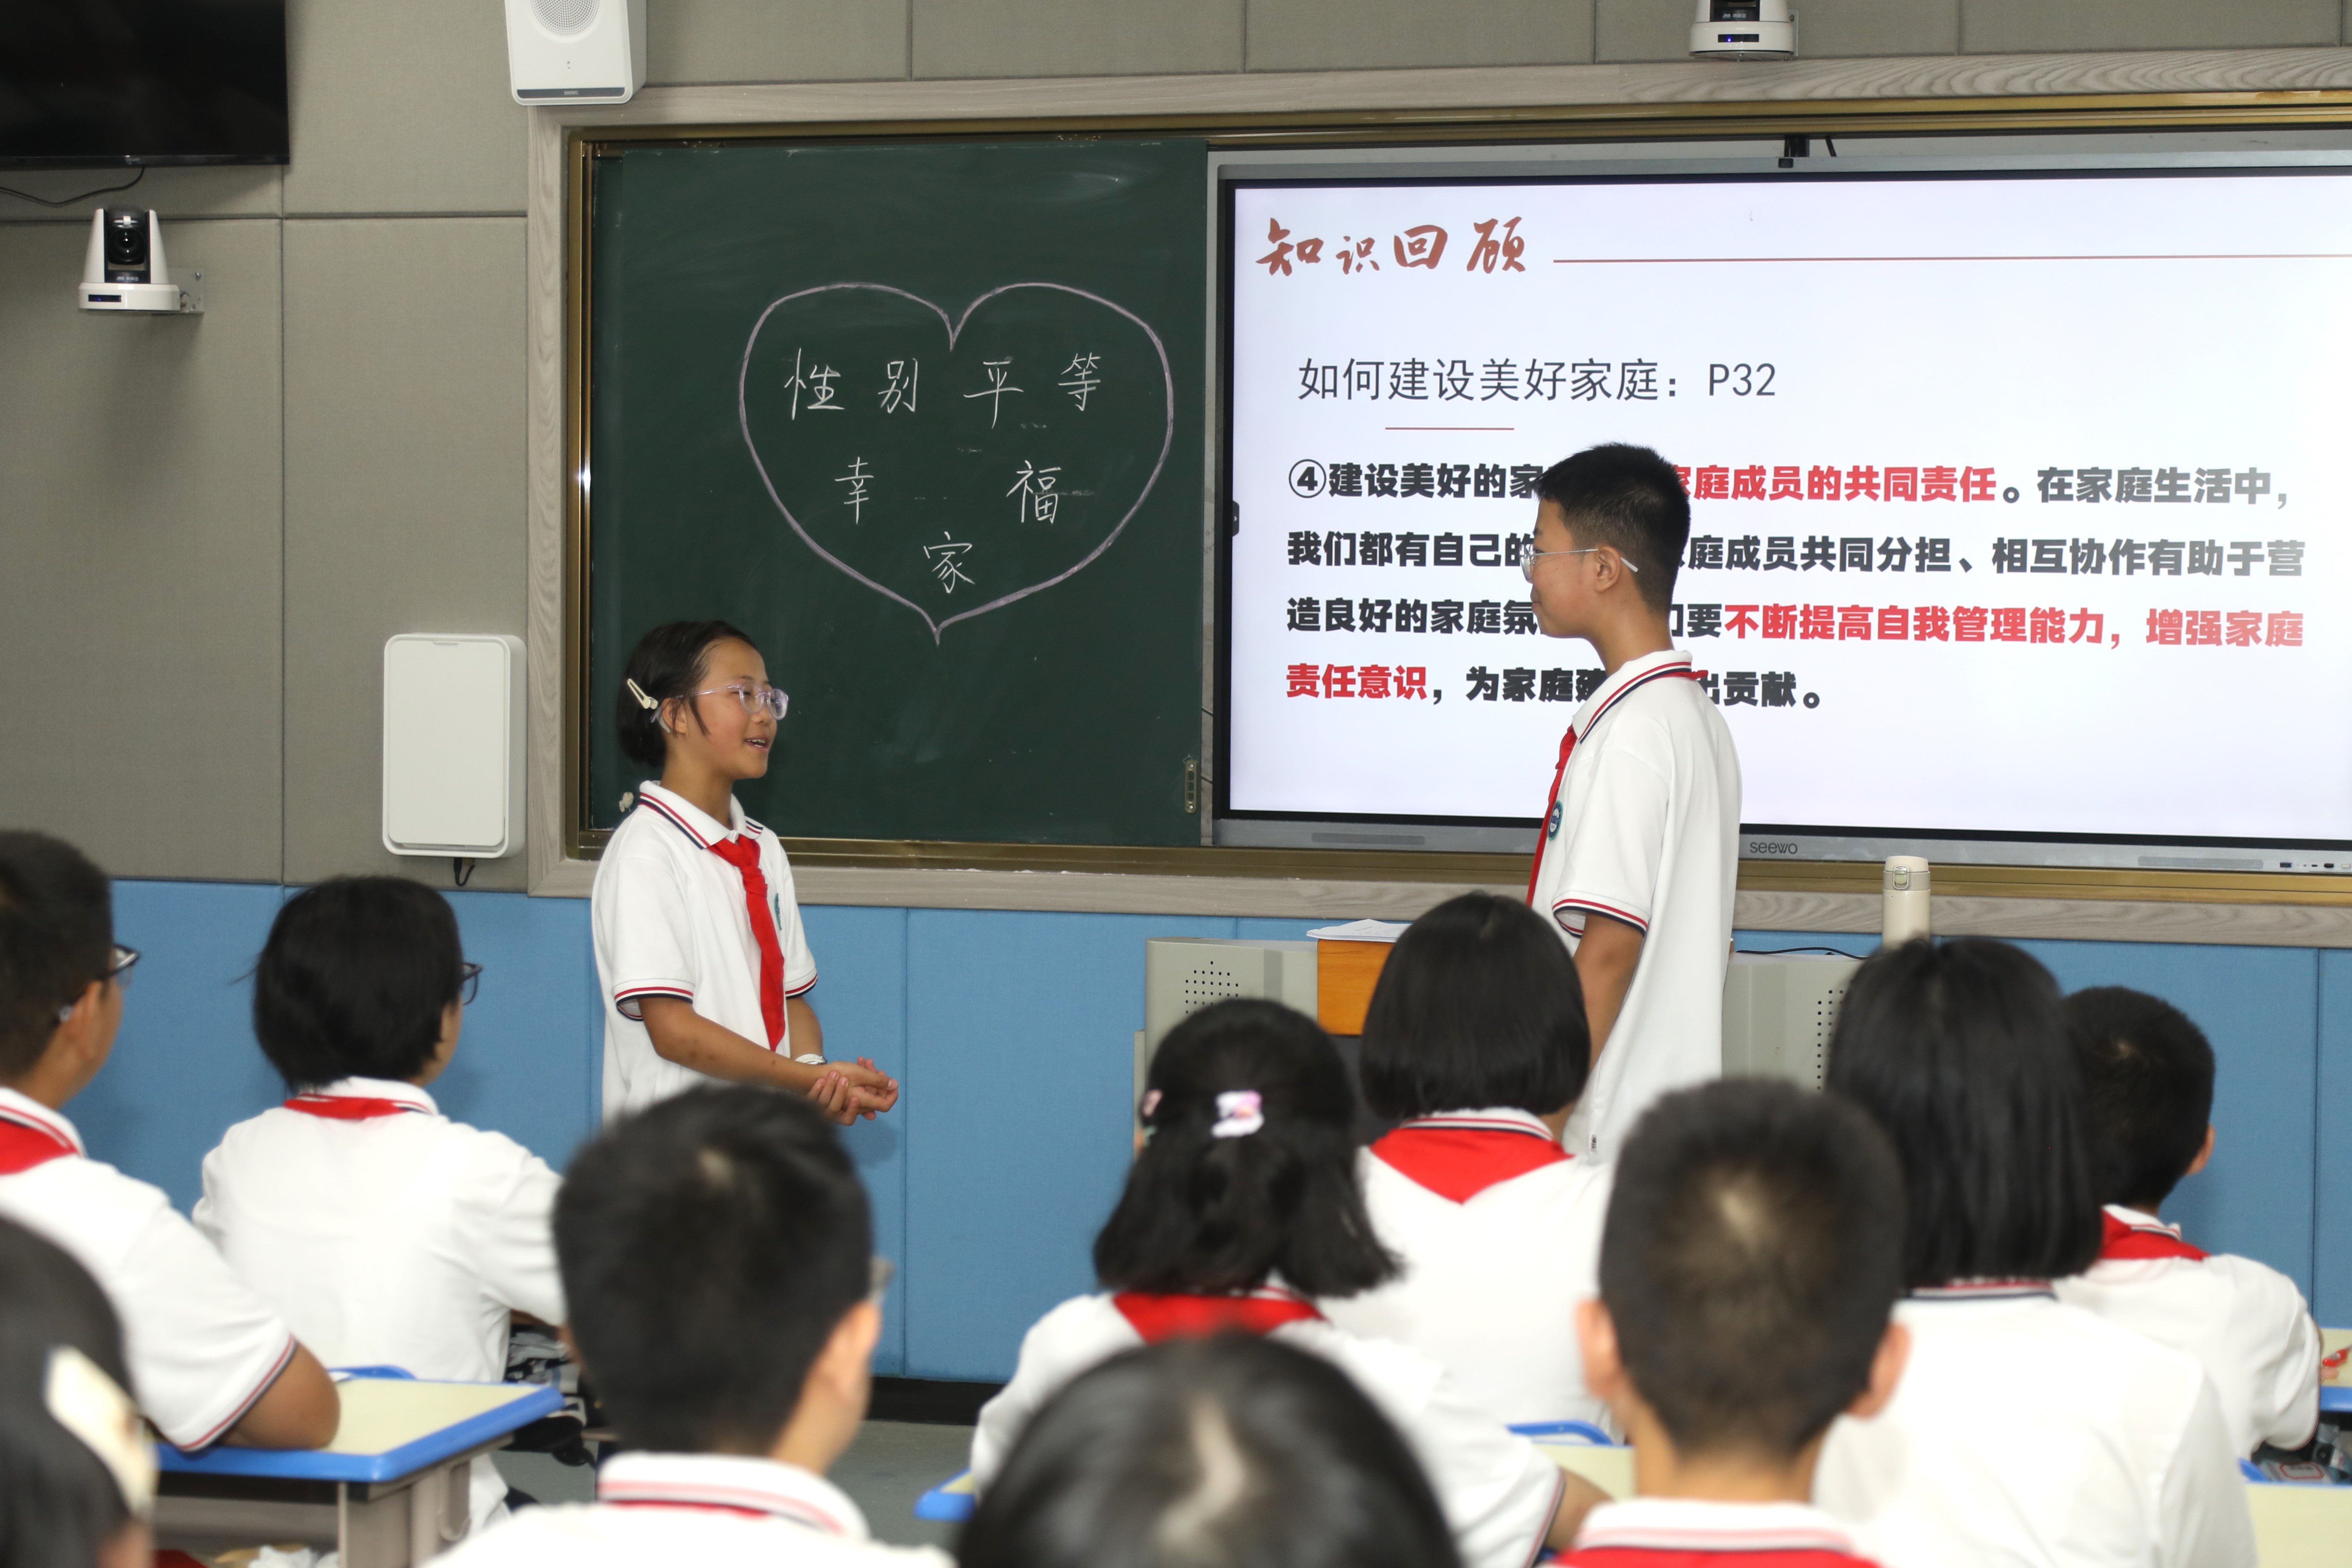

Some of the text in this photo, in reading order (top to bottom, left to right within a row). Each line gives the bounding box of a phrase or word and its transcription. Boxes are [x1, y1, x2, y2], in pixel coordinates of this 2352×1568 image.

[1256, 217, 1526, 276] 知识回顾
[784, 347, 1101, 429] 性别平等
[835, 457, 1062, 524] 幸 福
[923, 531, 975, 593] 家
[1750, 842, 1798, 854] seewo
